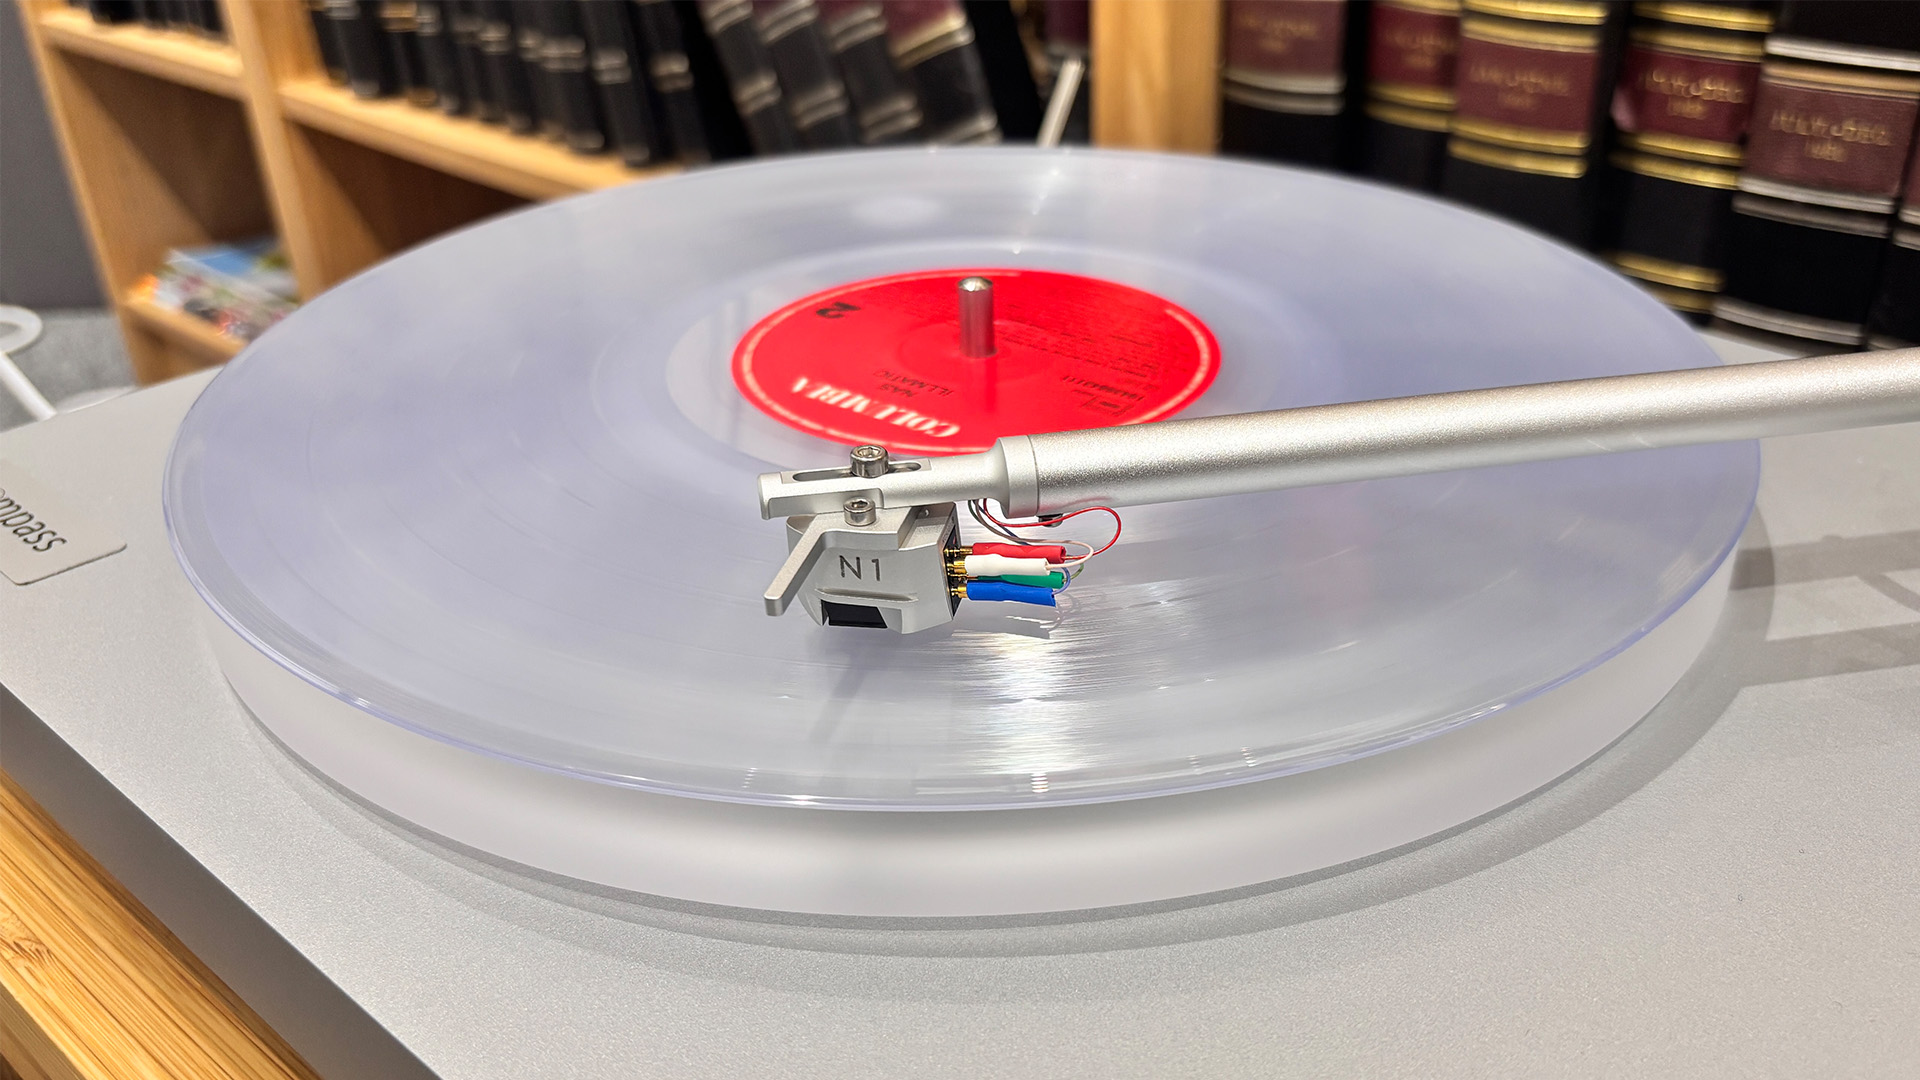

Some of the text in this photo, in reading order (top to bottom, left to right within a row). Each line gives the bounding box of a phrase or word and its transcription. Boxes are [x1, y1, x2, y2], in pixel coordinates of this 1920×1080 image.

[816, 302, 862, 319] 2
[792, 377, 960, 438] COLUMBIA
[0, 488, 67, 552] mpass
[839, 555, 880, 581] N1
